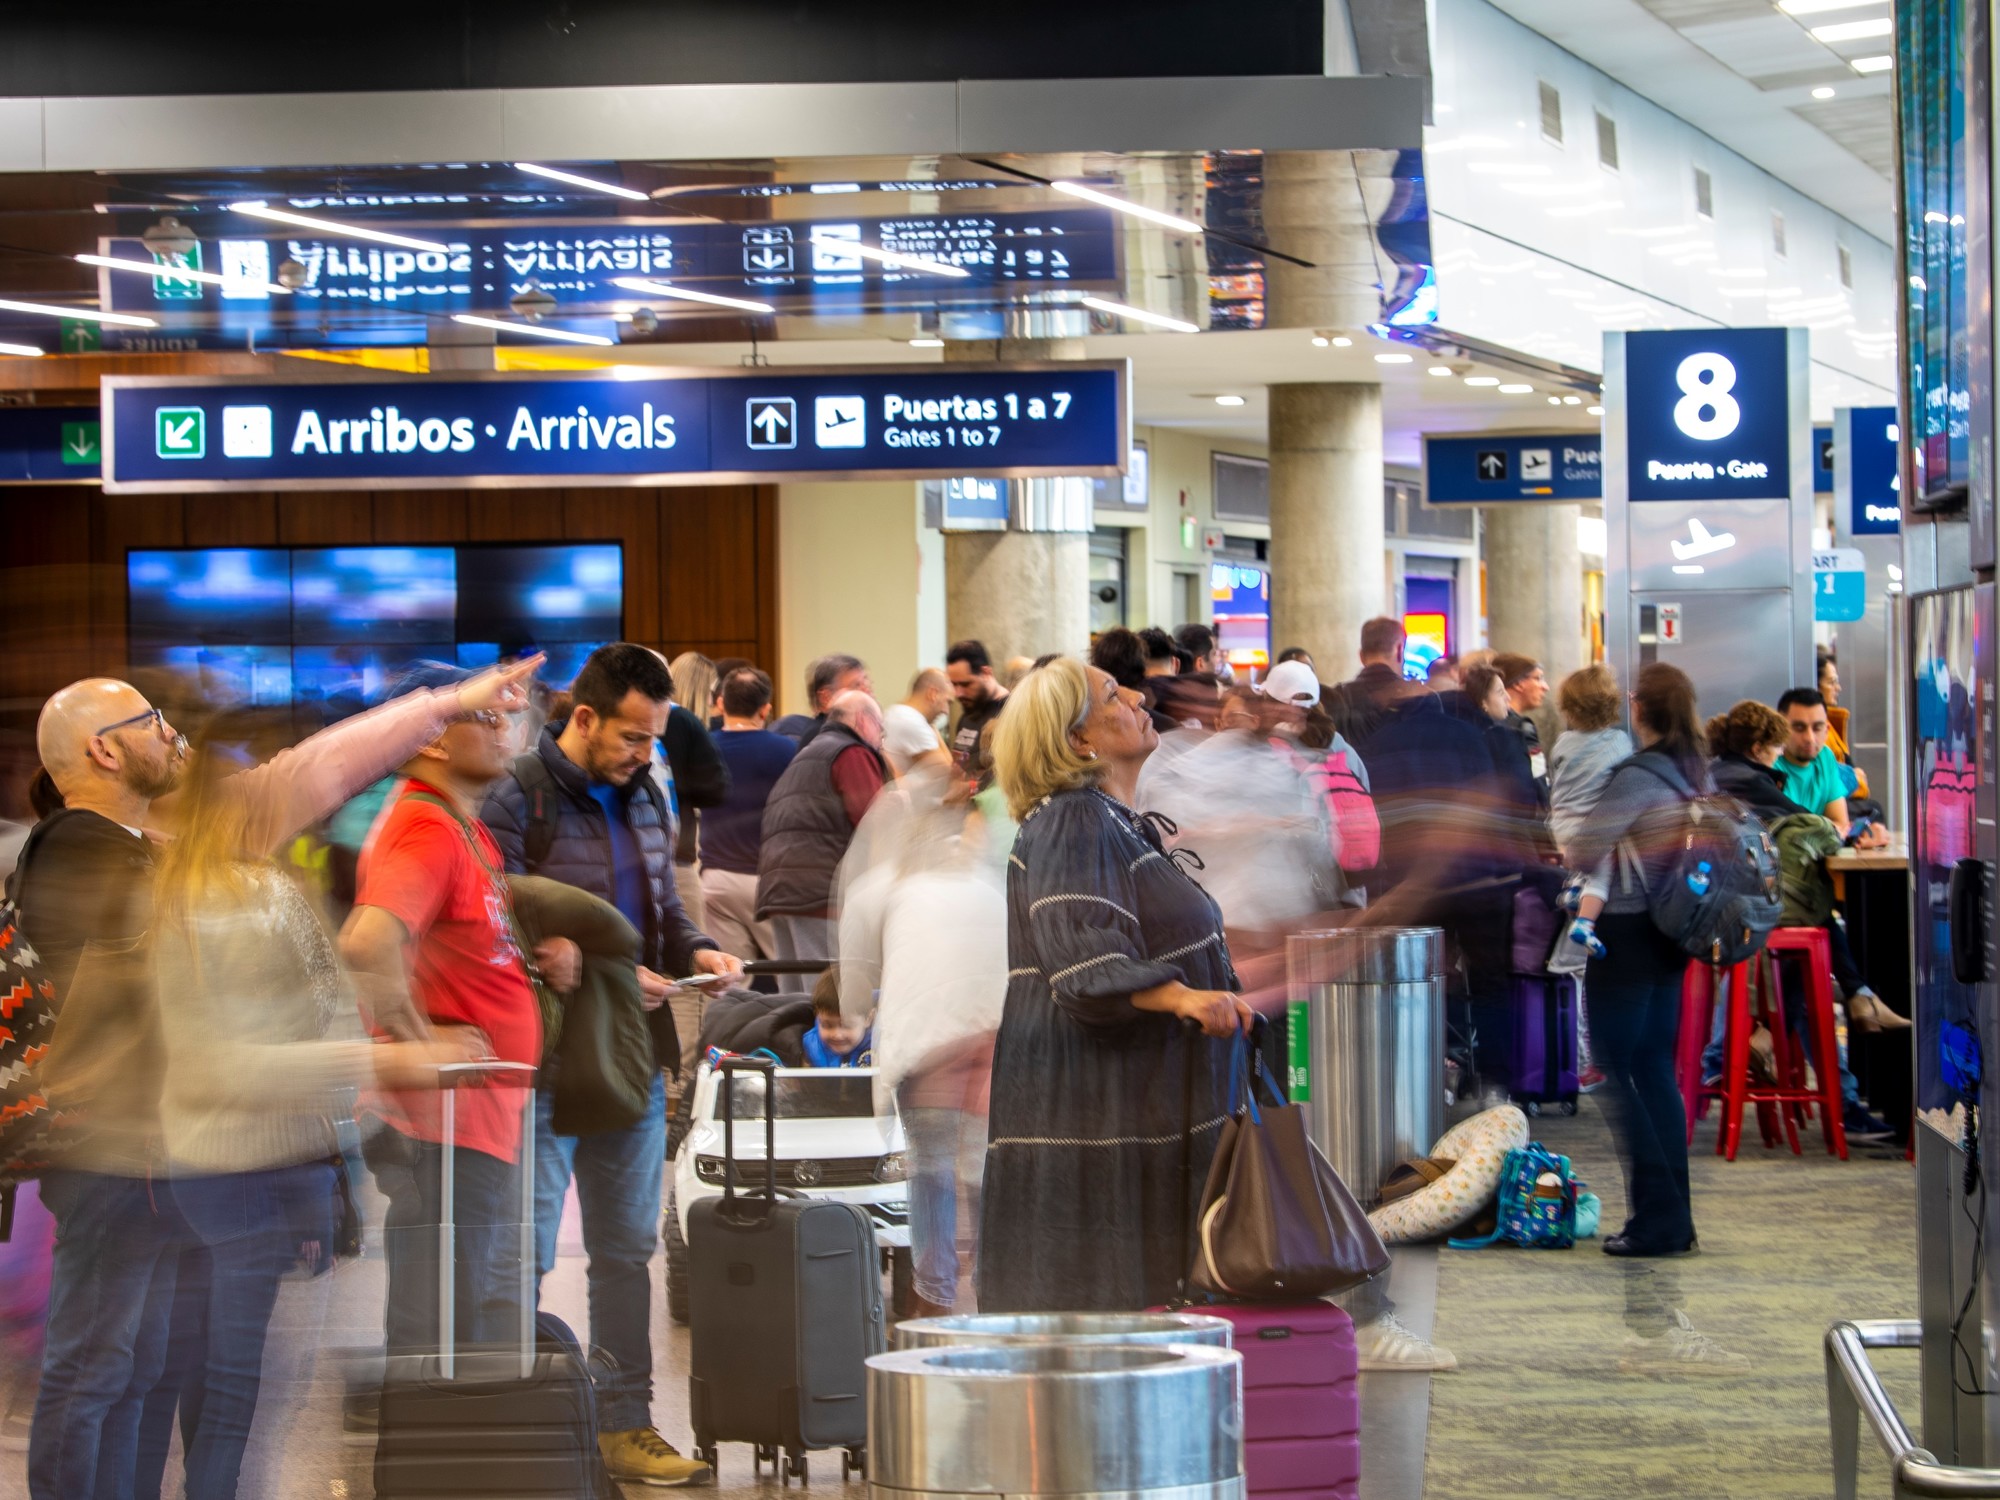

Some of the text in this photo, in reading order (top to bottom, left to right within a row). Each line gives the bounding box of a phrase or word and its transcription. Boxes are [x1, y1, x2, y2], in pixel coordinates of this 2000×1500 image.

[884, 392, 1072, 423] Puertas 1 a 7
[1674, 352, 1741, 441] 8
[292, 402, 676, 454] Arribos Arrivals
[884, 426, 1002, 447] Gates 1 to 7
[1648, 459, 1768, 481] Puerta Gate
